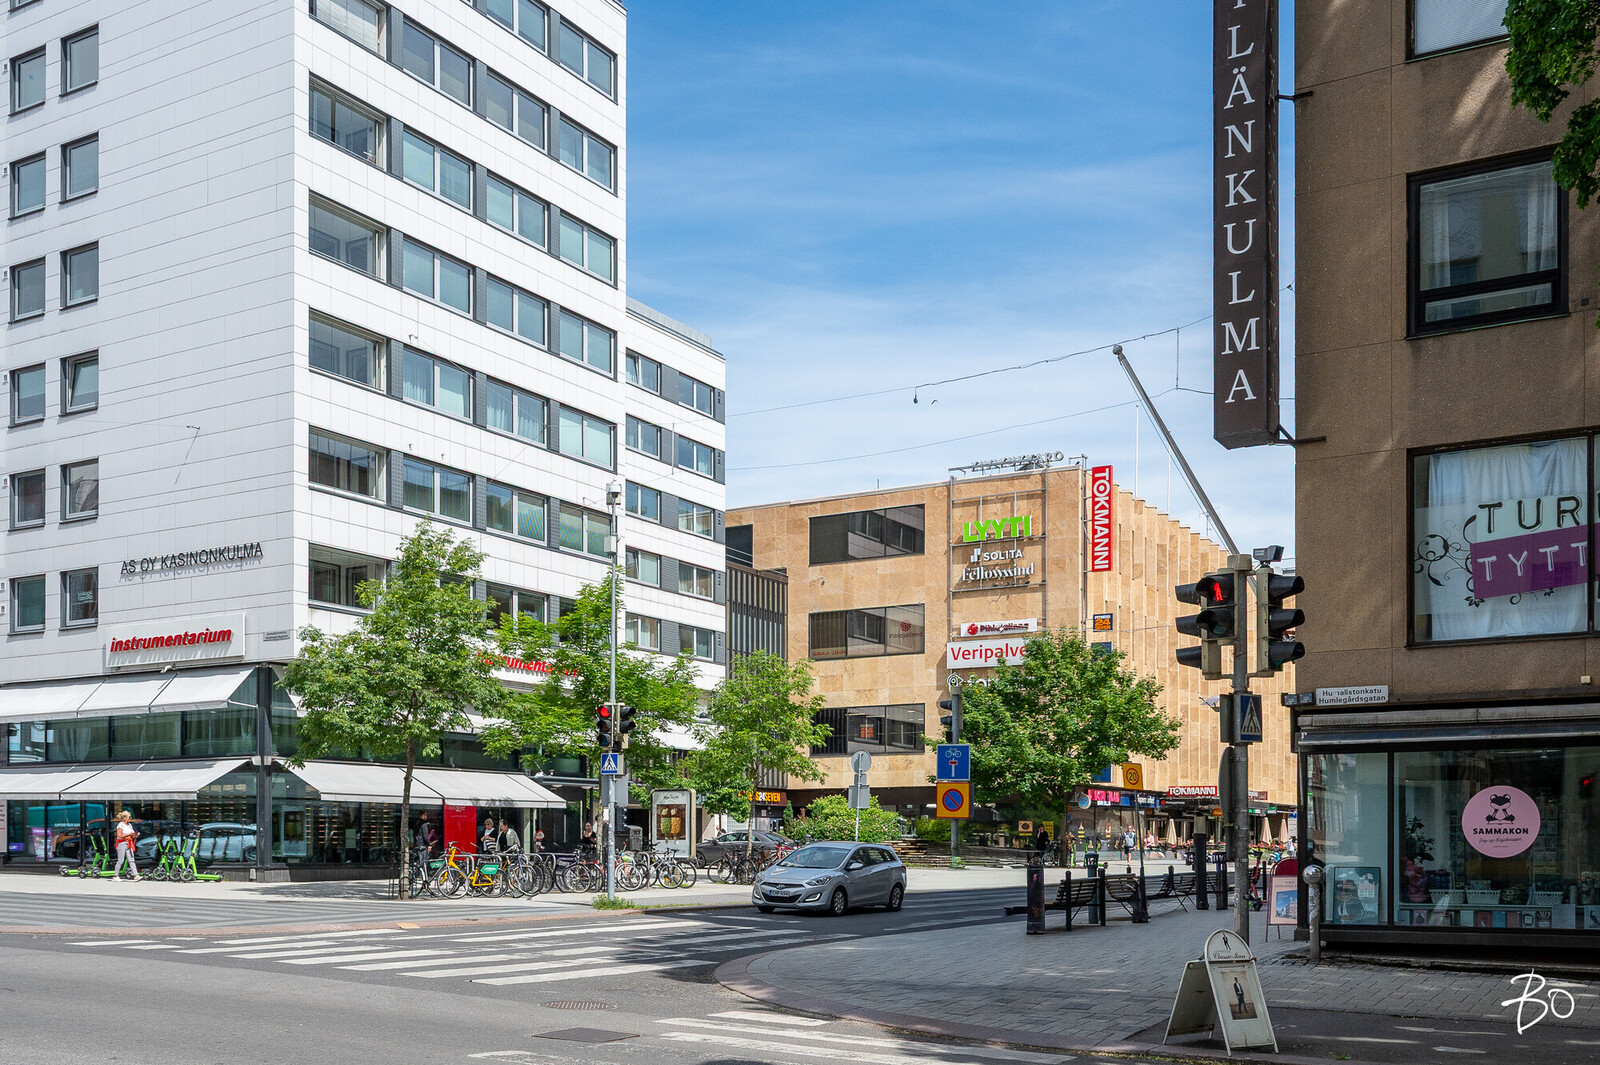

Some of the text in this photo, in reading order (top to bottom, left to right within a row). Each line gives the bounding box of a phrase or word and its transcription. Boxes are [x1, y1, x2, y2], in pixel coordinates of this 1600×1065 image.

[1221, 0, 1260, 404] LÄNKULMA
[1093, 467, 1111, 570] TOKMANNI
[1478, 494, 1600, 534] TUR
[962, 515, 1032, 543] LYYTI
[120, 542, 263, 575] AS OY KASINONKULMA
[983, 549, 1024, 561] SOLITA
[109, 627, 232, 652] instrumentarium
[889, 631, 923, 640] Pihlajalinna
[1318, 695, 1386, 704] Humlegårdsgatan
[1128, 772, 1136, 781] 20
[1168, 786, 1216, 796] TOKMANNI
